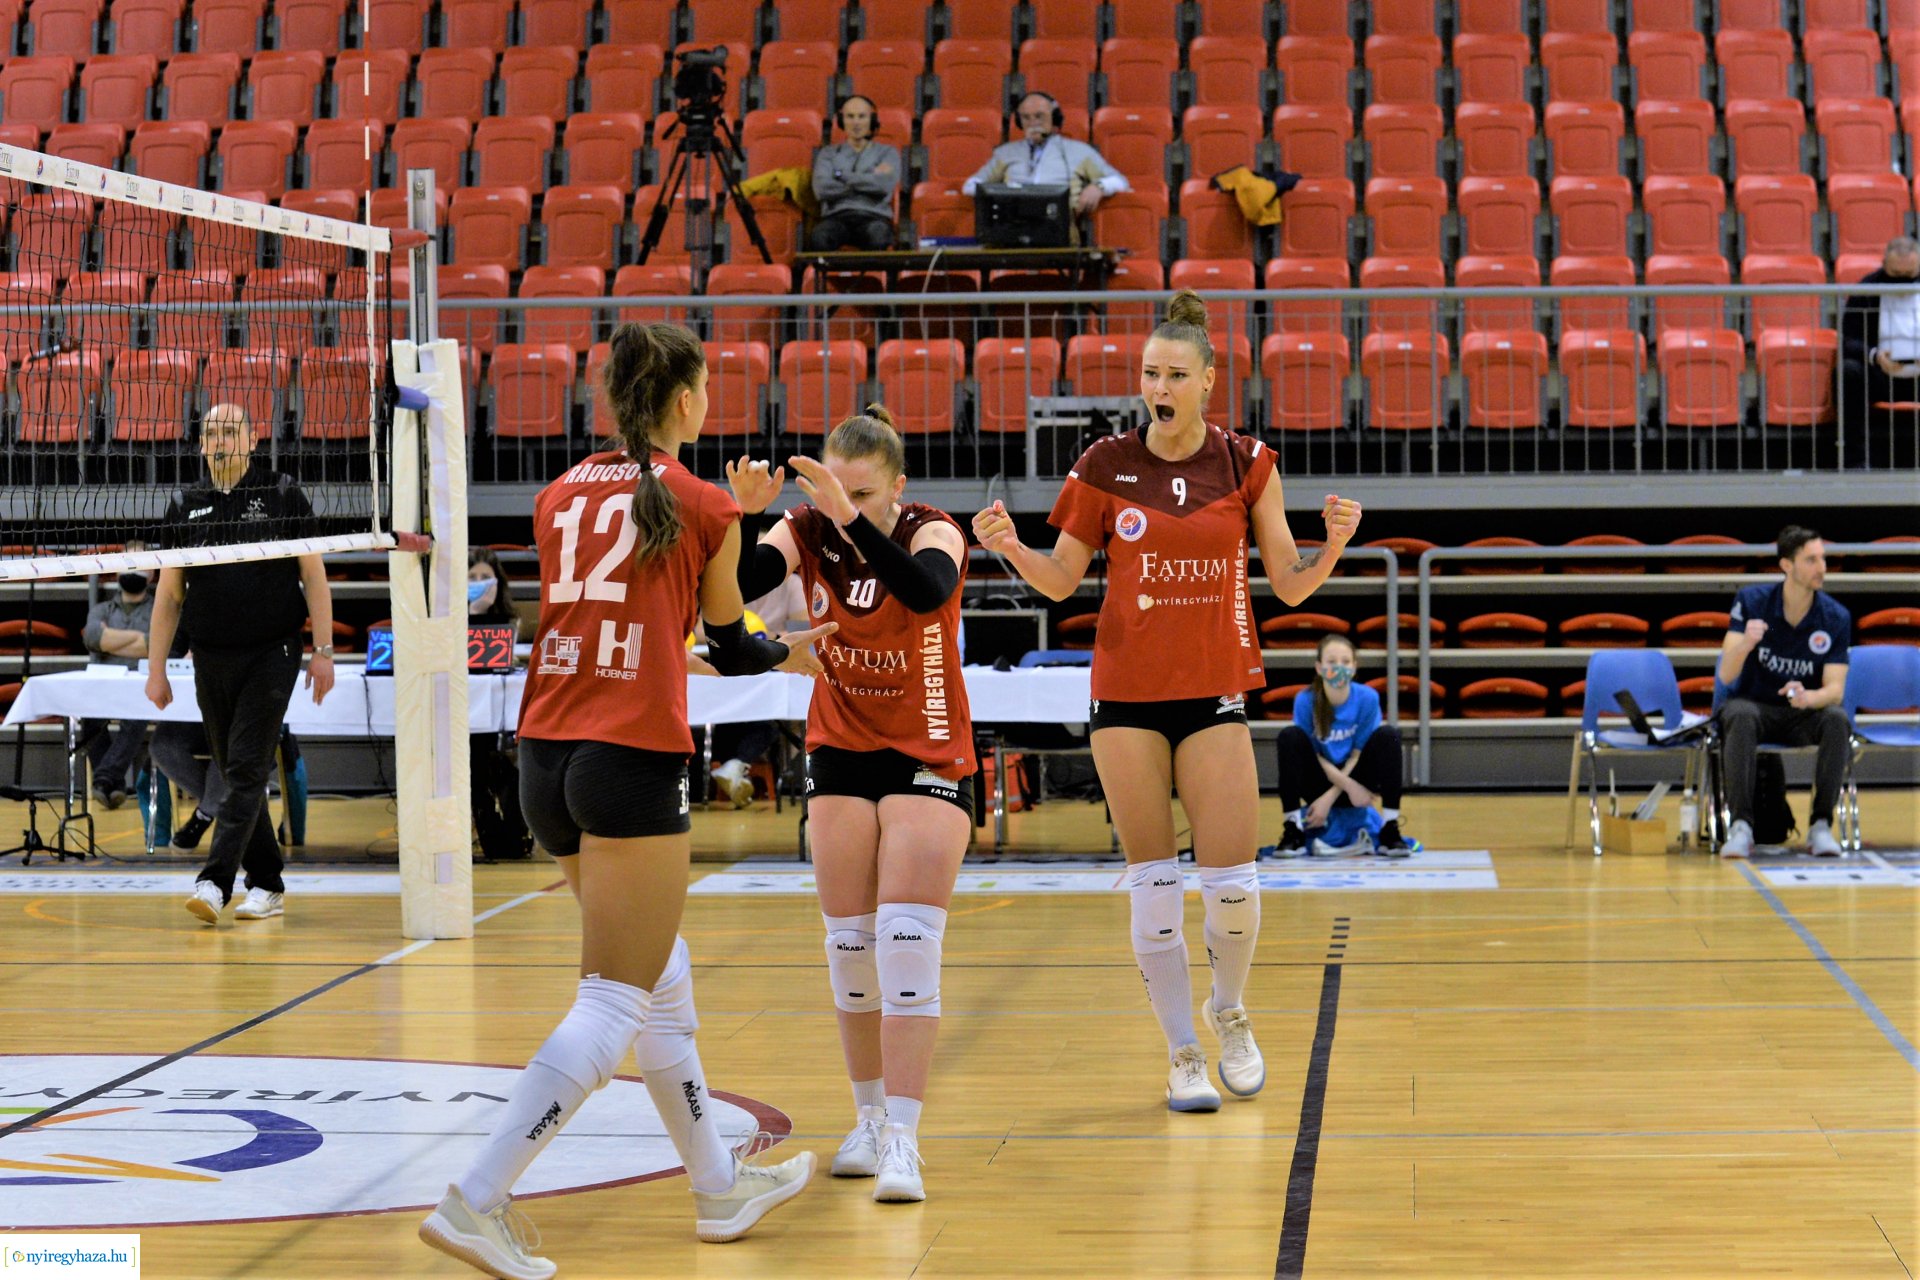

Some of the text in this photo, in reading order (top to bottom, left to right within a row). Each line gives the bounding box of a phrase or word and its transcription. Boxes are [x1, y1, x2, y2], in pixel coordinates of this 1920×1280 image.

[564, 462, 668, 484] RADOSOA
[1115, 474, 1138, 483] JAKO
[1171, 477, 1187, 506] 9
[549, 493, 639, 604] 12
[822, 545, 840, 563] JAKO
[1139, 551, 1227, 578] FATUM
[846, 578, 877, 608] 10
[1139, 575, 1227, 584] PROPERT
[919, 622, 950, 740] NYÍREGYHÁZA
